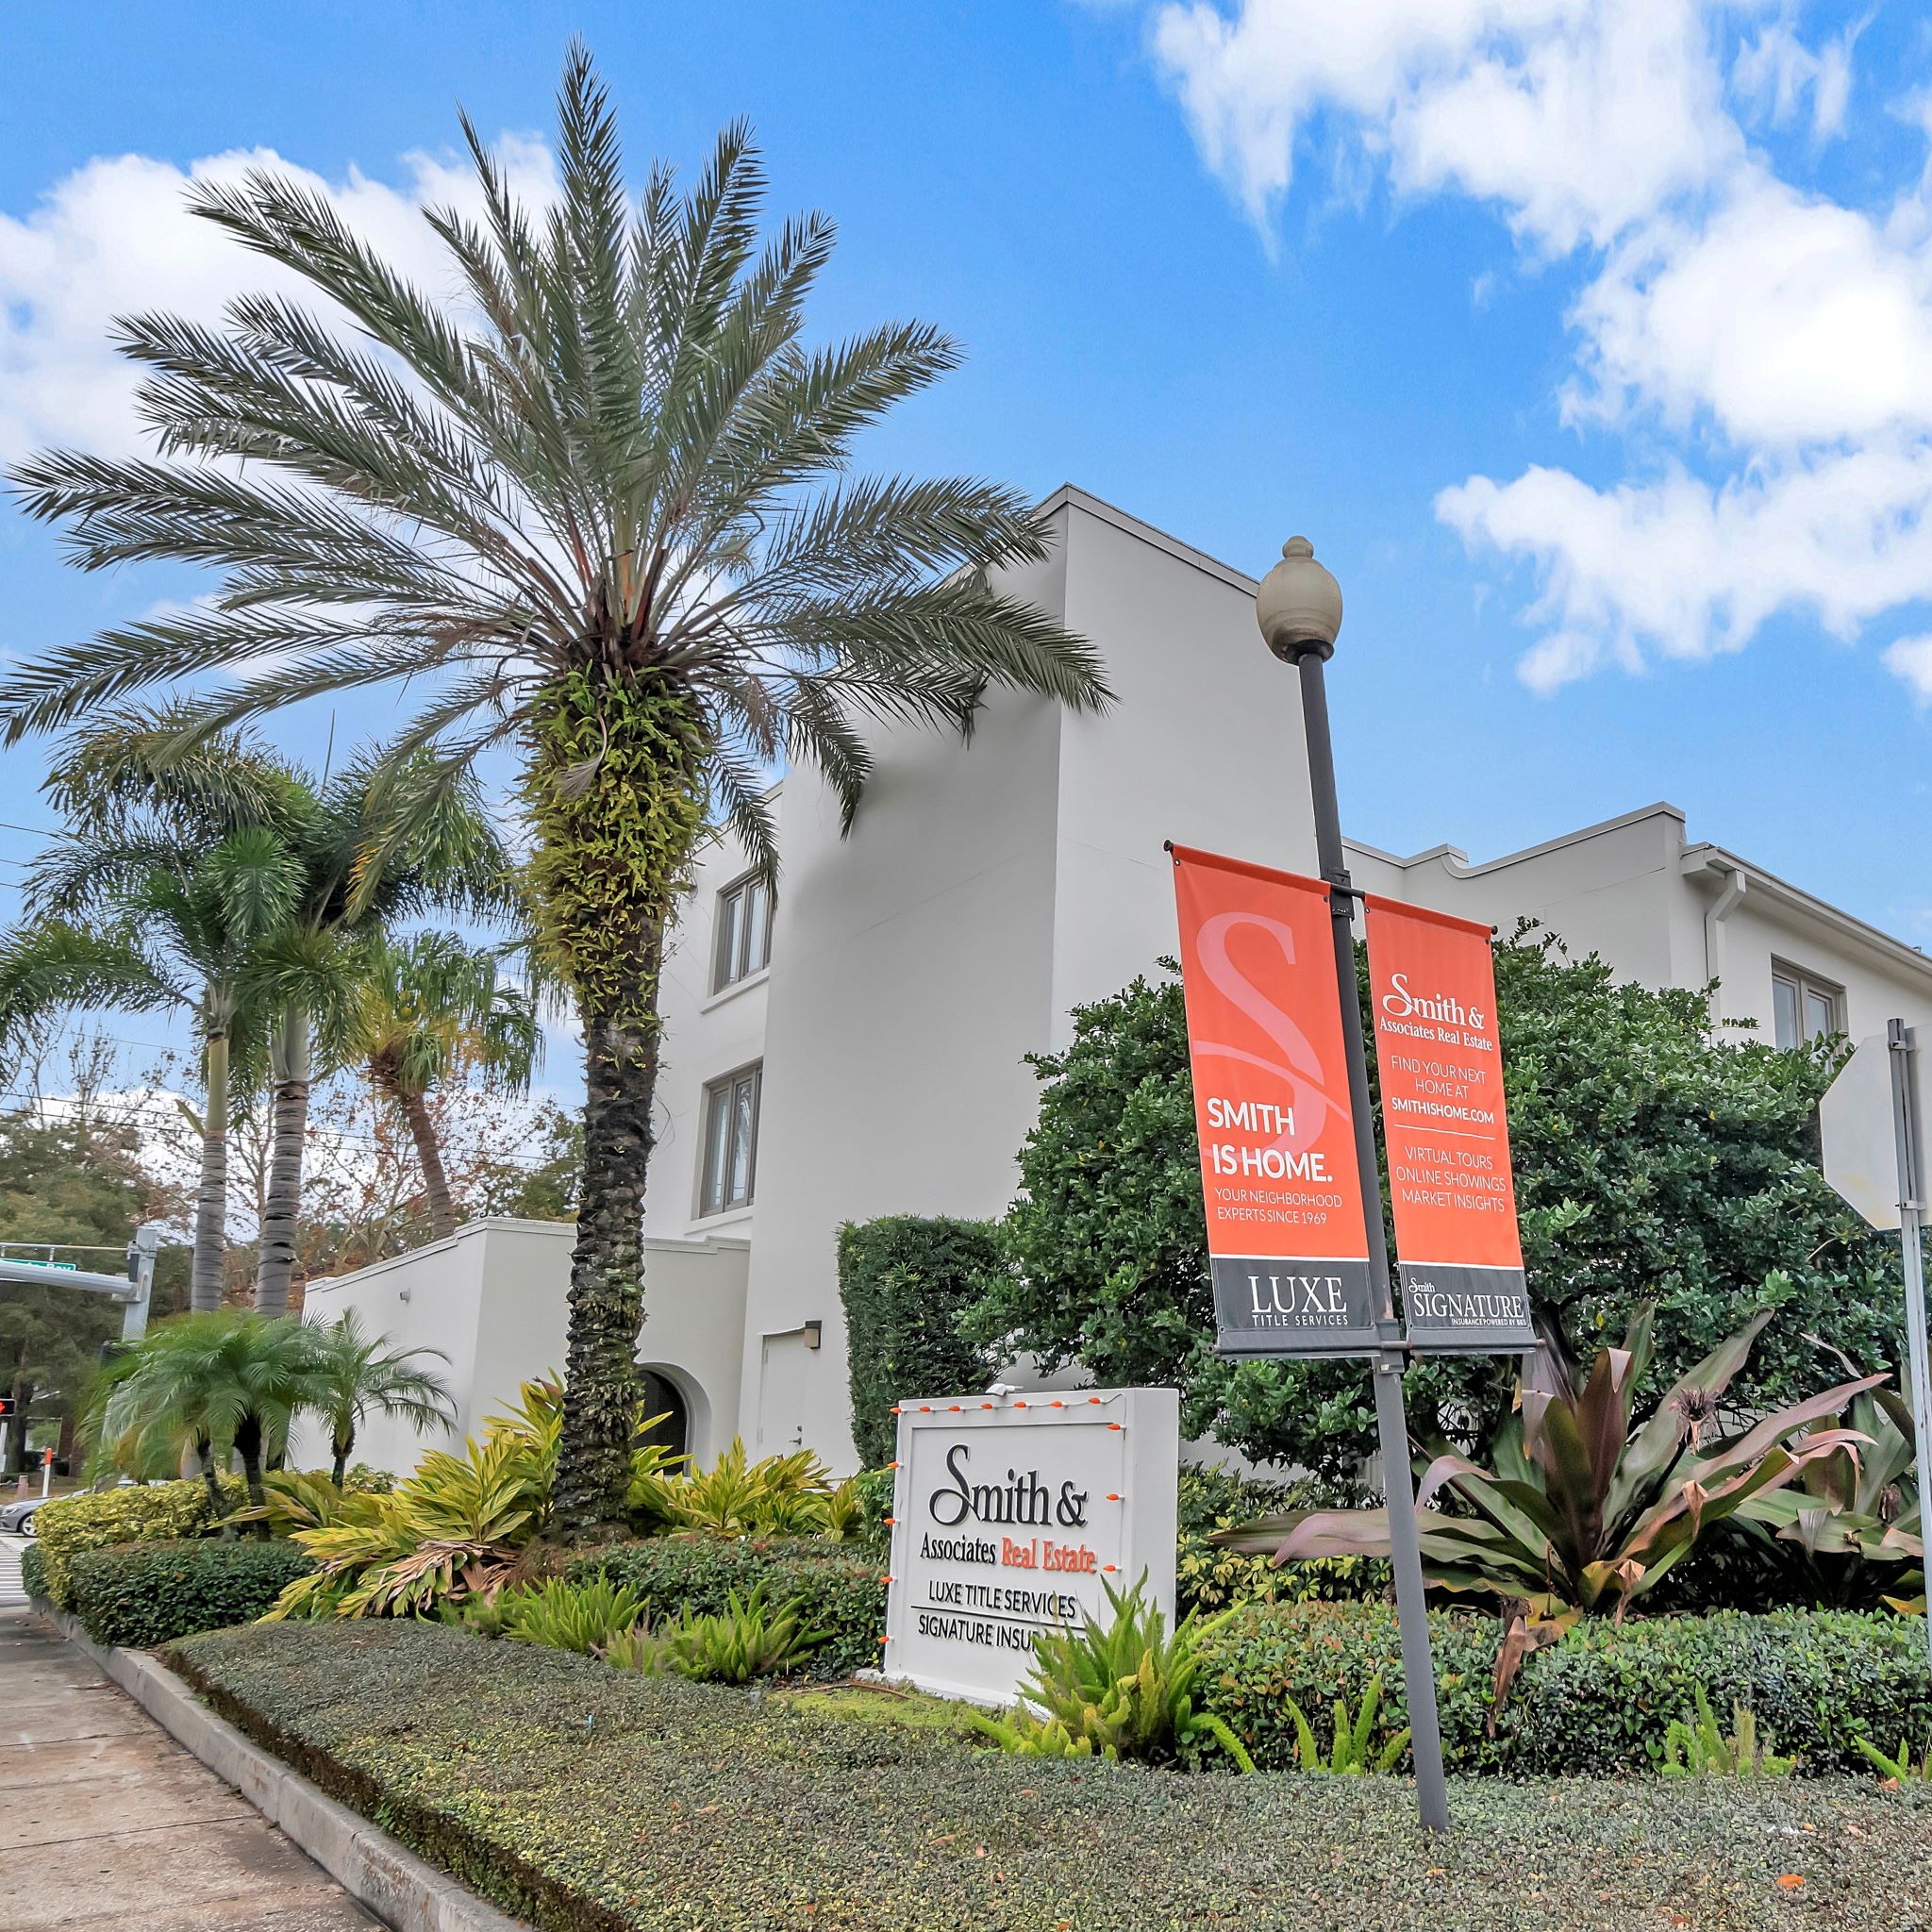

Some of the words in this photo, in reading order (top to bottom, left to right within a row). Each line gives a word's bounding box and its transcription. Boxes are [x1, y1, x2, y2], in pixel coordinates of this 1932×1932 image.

[1382, 973, 1467, 1026] Smith
[1468, 1007, 1485, 1029] &
[1380, 1016, 1435, 1041] Associates
[1437, 1026, 1460, 1045] Real
[1462, 1032, 1493, 1051] Estate
[1391, 1055, 1421, 1074] FIND
[1422, 1060, 1457, 1079] YOUR
[1458, 1067, 1486, 1084] NEXT
[1415, 1078, 1453, 1097] HOME
[1455, 1085, 1469, 1099] AT
[1207, 1097, 1295, 1136] SMITH
[1391, 1097, 1494, 1124] SMITHISHOME.COM
[1212, 1143, 1238, 1175] IS
[1241, 1146, 1333, 1182] HOME.
[1404, 1145, 1456, 1166] VIRTUAL
[1456, 1151, 1493, 1170] TOURS
[1396, 1166, 1442, 1186] ONLINE
[1444, 1171, 1507, 1191] SHOWINGS
[1215, 1187, 1247, 1203] YOUR
[1249, 1190, 1342, 1208] NEIGHBORHOOD
[1402, 1189, 1452, 1208] MARKET
[1454, 1193, 1505, 1212] INSIGHTS
[1217, 1207, 1266, 1222] EXPERTS
[1267, 1209, 1299, 1224] SINCE
[1301, 1211, 1327, 1224] 1969
[1247, 1275, 1347, 1313] LUXE
[1407, 1277, 1435, 1293] Smith
[1413, 1293, 1524, 1318] SIGNATURE
[1252, 1314, 1289, 1326] TITLE
[1295, 1314, 1349, 1326] SERVICES
[1451, 1317, 1482, 1326] INSURANCE
[1483, 1317, 1508, 1326] POWERED
[929, 1443, 1053, 1526] Smith
[1056, 1480, 1089, 1527] &
[920, 1531, 996, 1565] Associates
[1001, 1537, 1039, 1569] Real
[1042, 1540, 1097, 1574] Estate
[929, 1580, 961, 1604] LUXE
[965, 1584, 1002, 1609] TITLE
[1004, 1589, 1076, 1619] SERVICES
[918, 1614, 992, 1646] SIGNATURE
